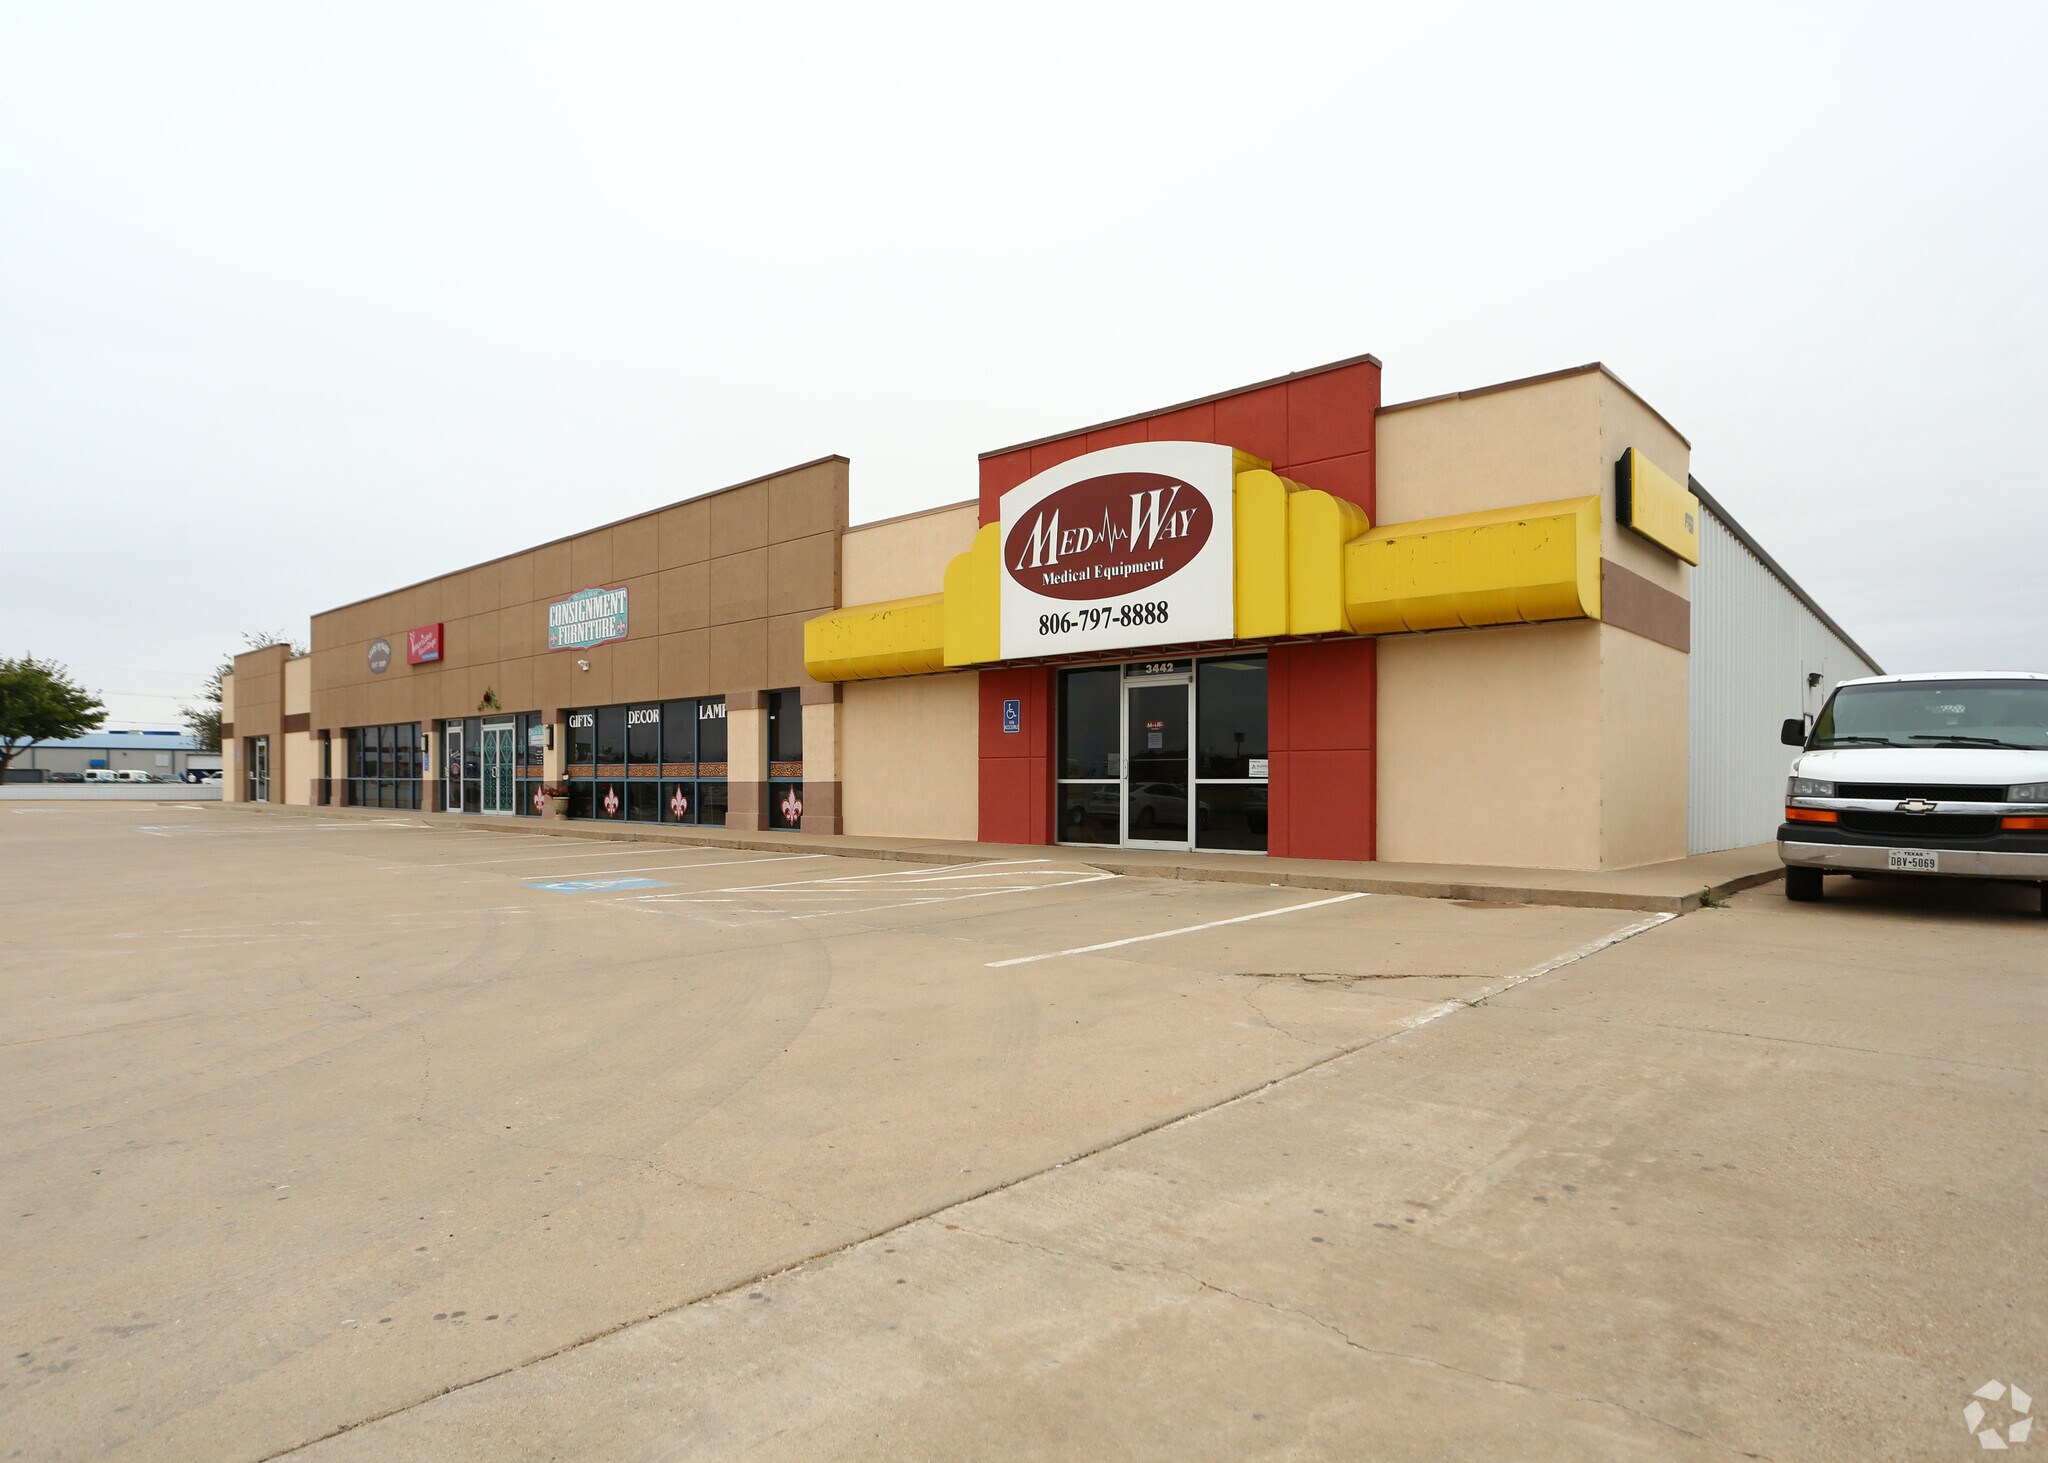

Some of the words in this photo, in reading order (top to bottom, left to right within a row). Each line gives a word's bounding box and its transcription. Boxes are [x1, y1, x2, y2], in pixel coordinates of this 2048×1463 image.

[1042, 566, 1090, 586] Medical
[1094, 556, 1165, 580] Equipment
[549, 589, 627, 628] CONSIGNMENT
[1038, 600, 1169, 637] 806-797-8888
[558, 616, 617, 647] FURNITURE
[1145, 662, 1174, 675] 3442
[569, 713, 594, 729] GIFTS
[628, 708, 660, 725] DECOR
